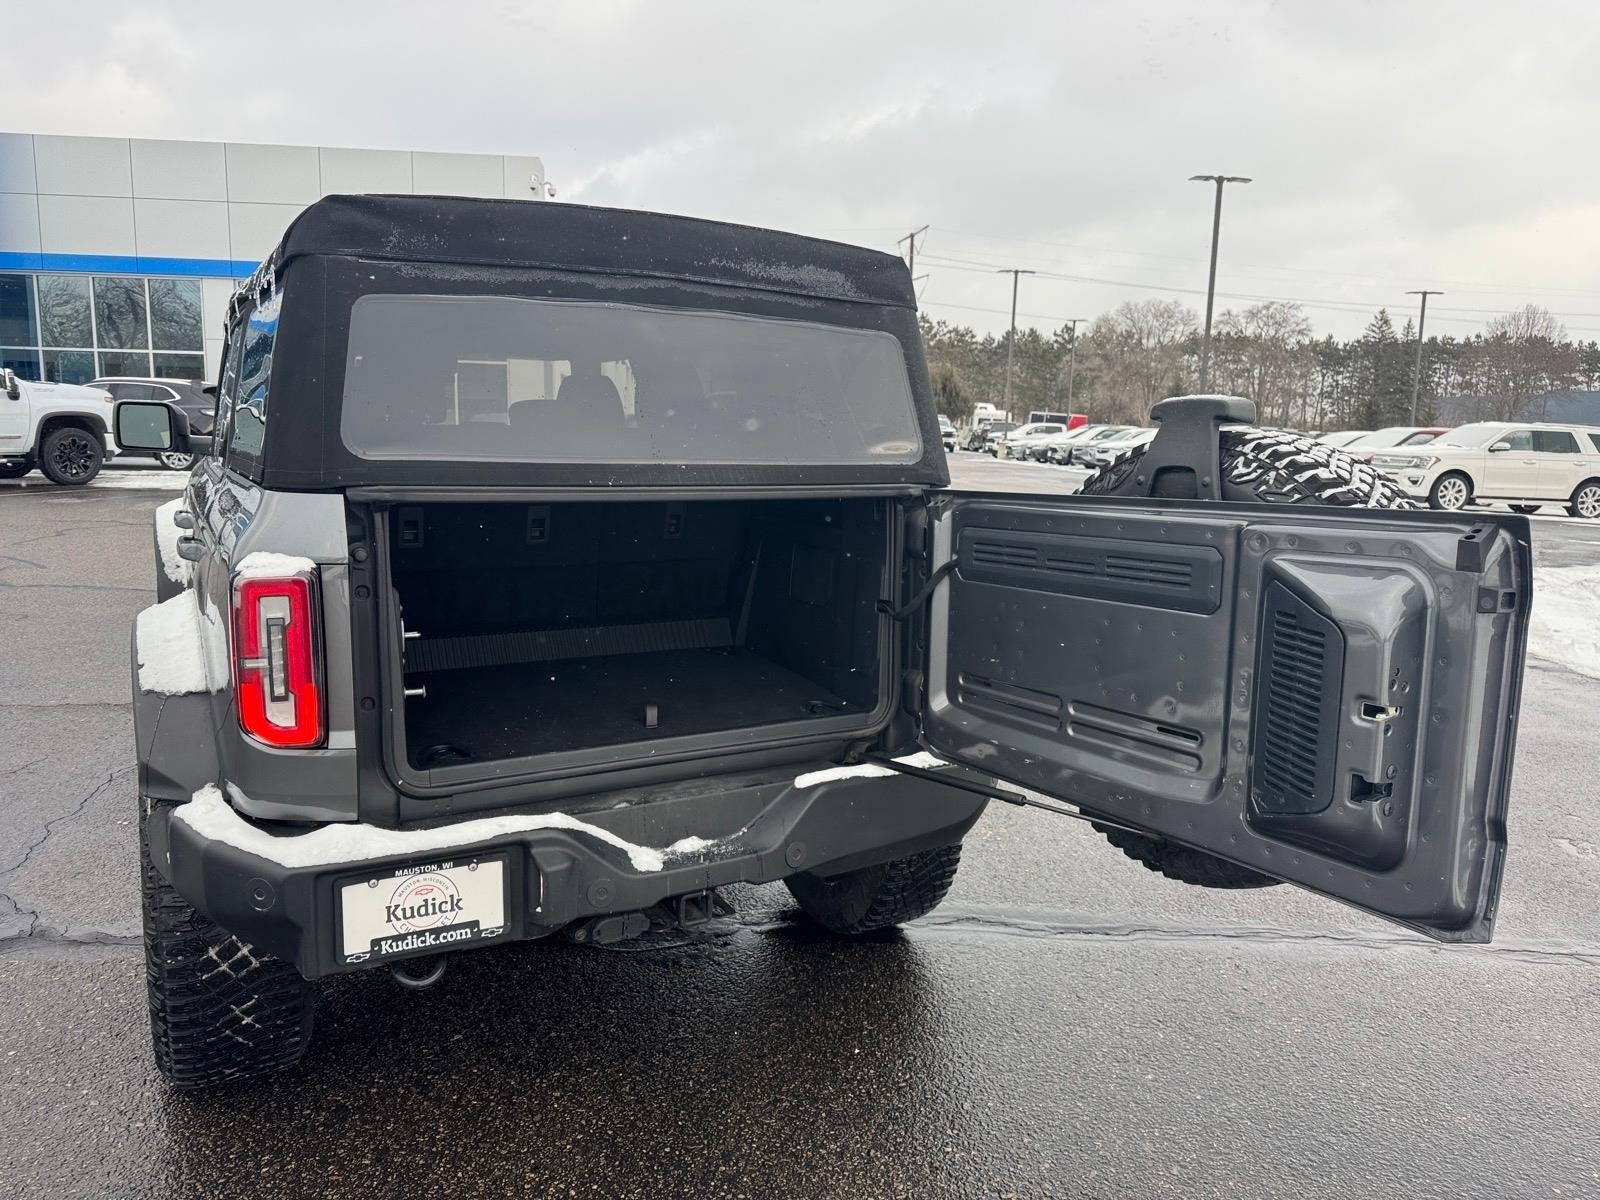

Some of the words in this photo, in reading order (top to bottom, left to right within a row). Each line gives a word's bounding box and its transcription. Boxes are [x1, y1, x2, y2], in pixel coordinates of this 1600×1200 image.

[394, 864, 440, 877] MAUSTON,
[442, 861, 453, 869] WI
[385, 894, 463, 923] Kudick
[380, 927, 472, 954] Kudick.com
